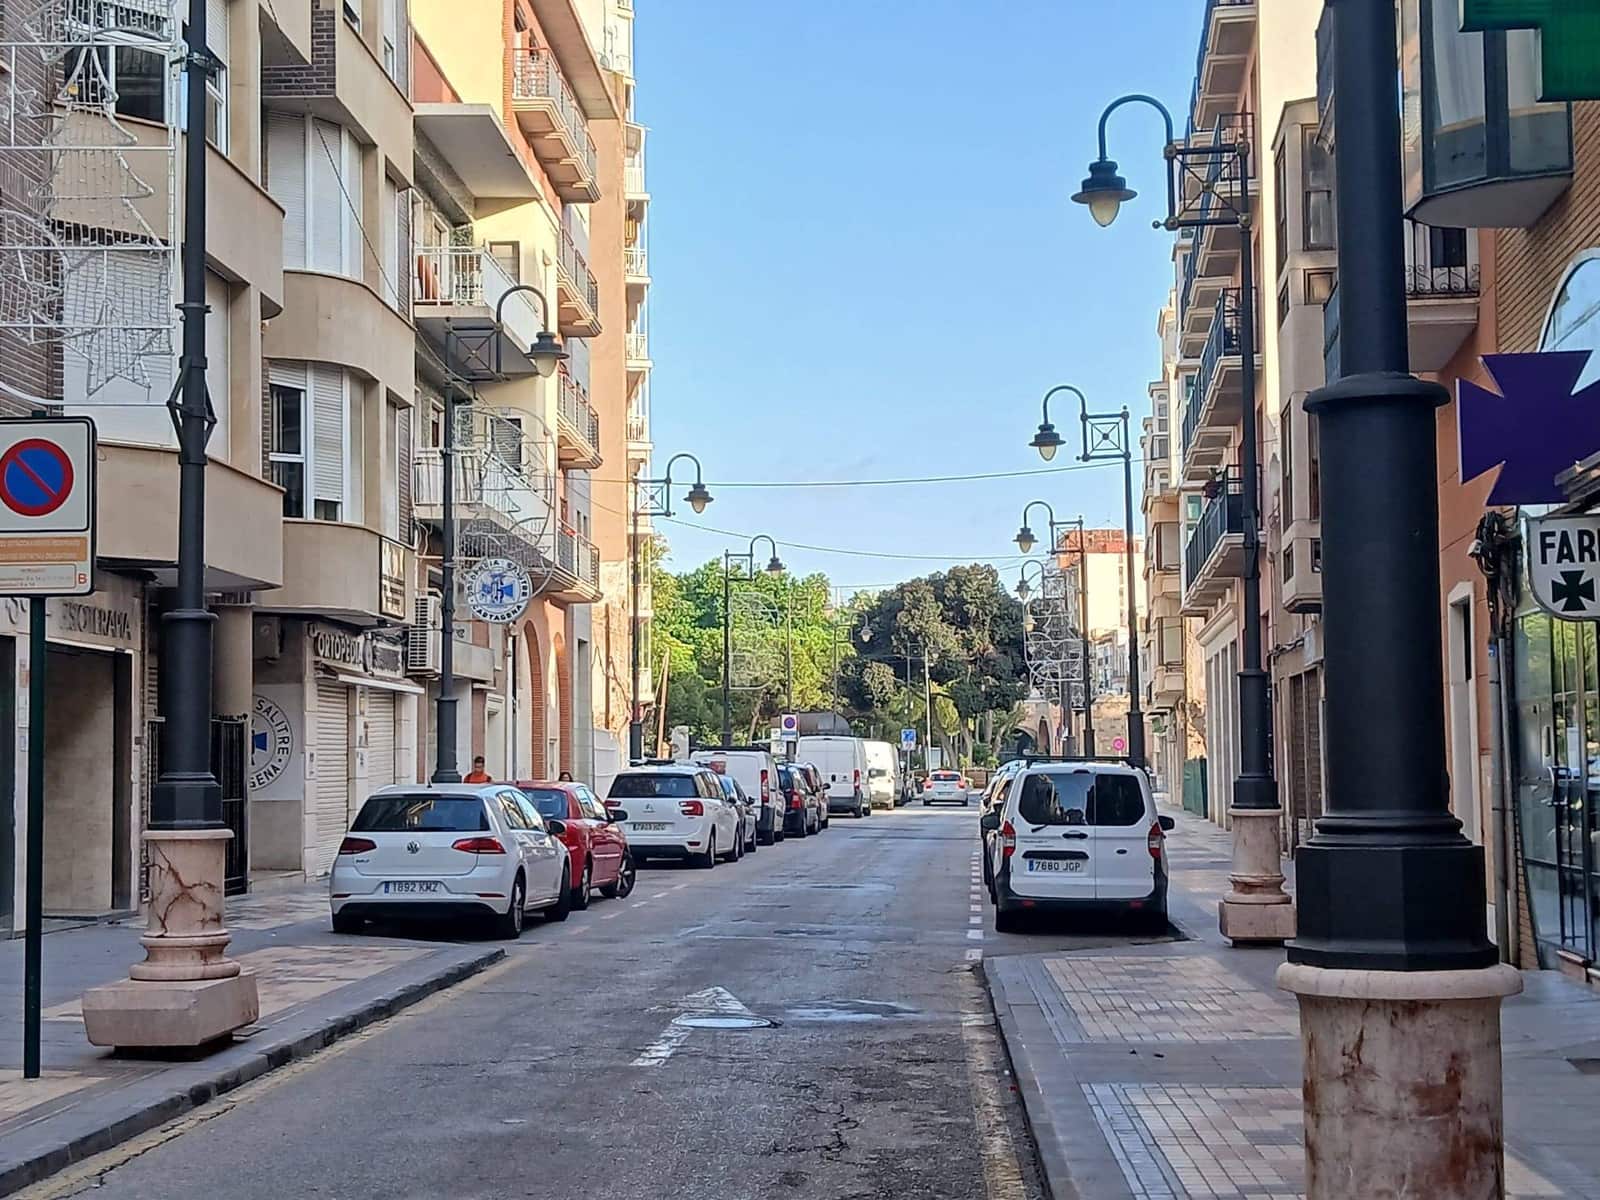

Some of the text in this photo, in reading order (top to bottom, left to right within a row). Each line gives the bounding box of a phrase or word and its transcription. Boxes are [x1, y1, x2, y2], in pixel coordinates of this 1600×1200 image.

[1540, 529, 1600, 565] FAR
[78, 573, 88, 585] B
[255, 699, 290, 755] SALITRE
